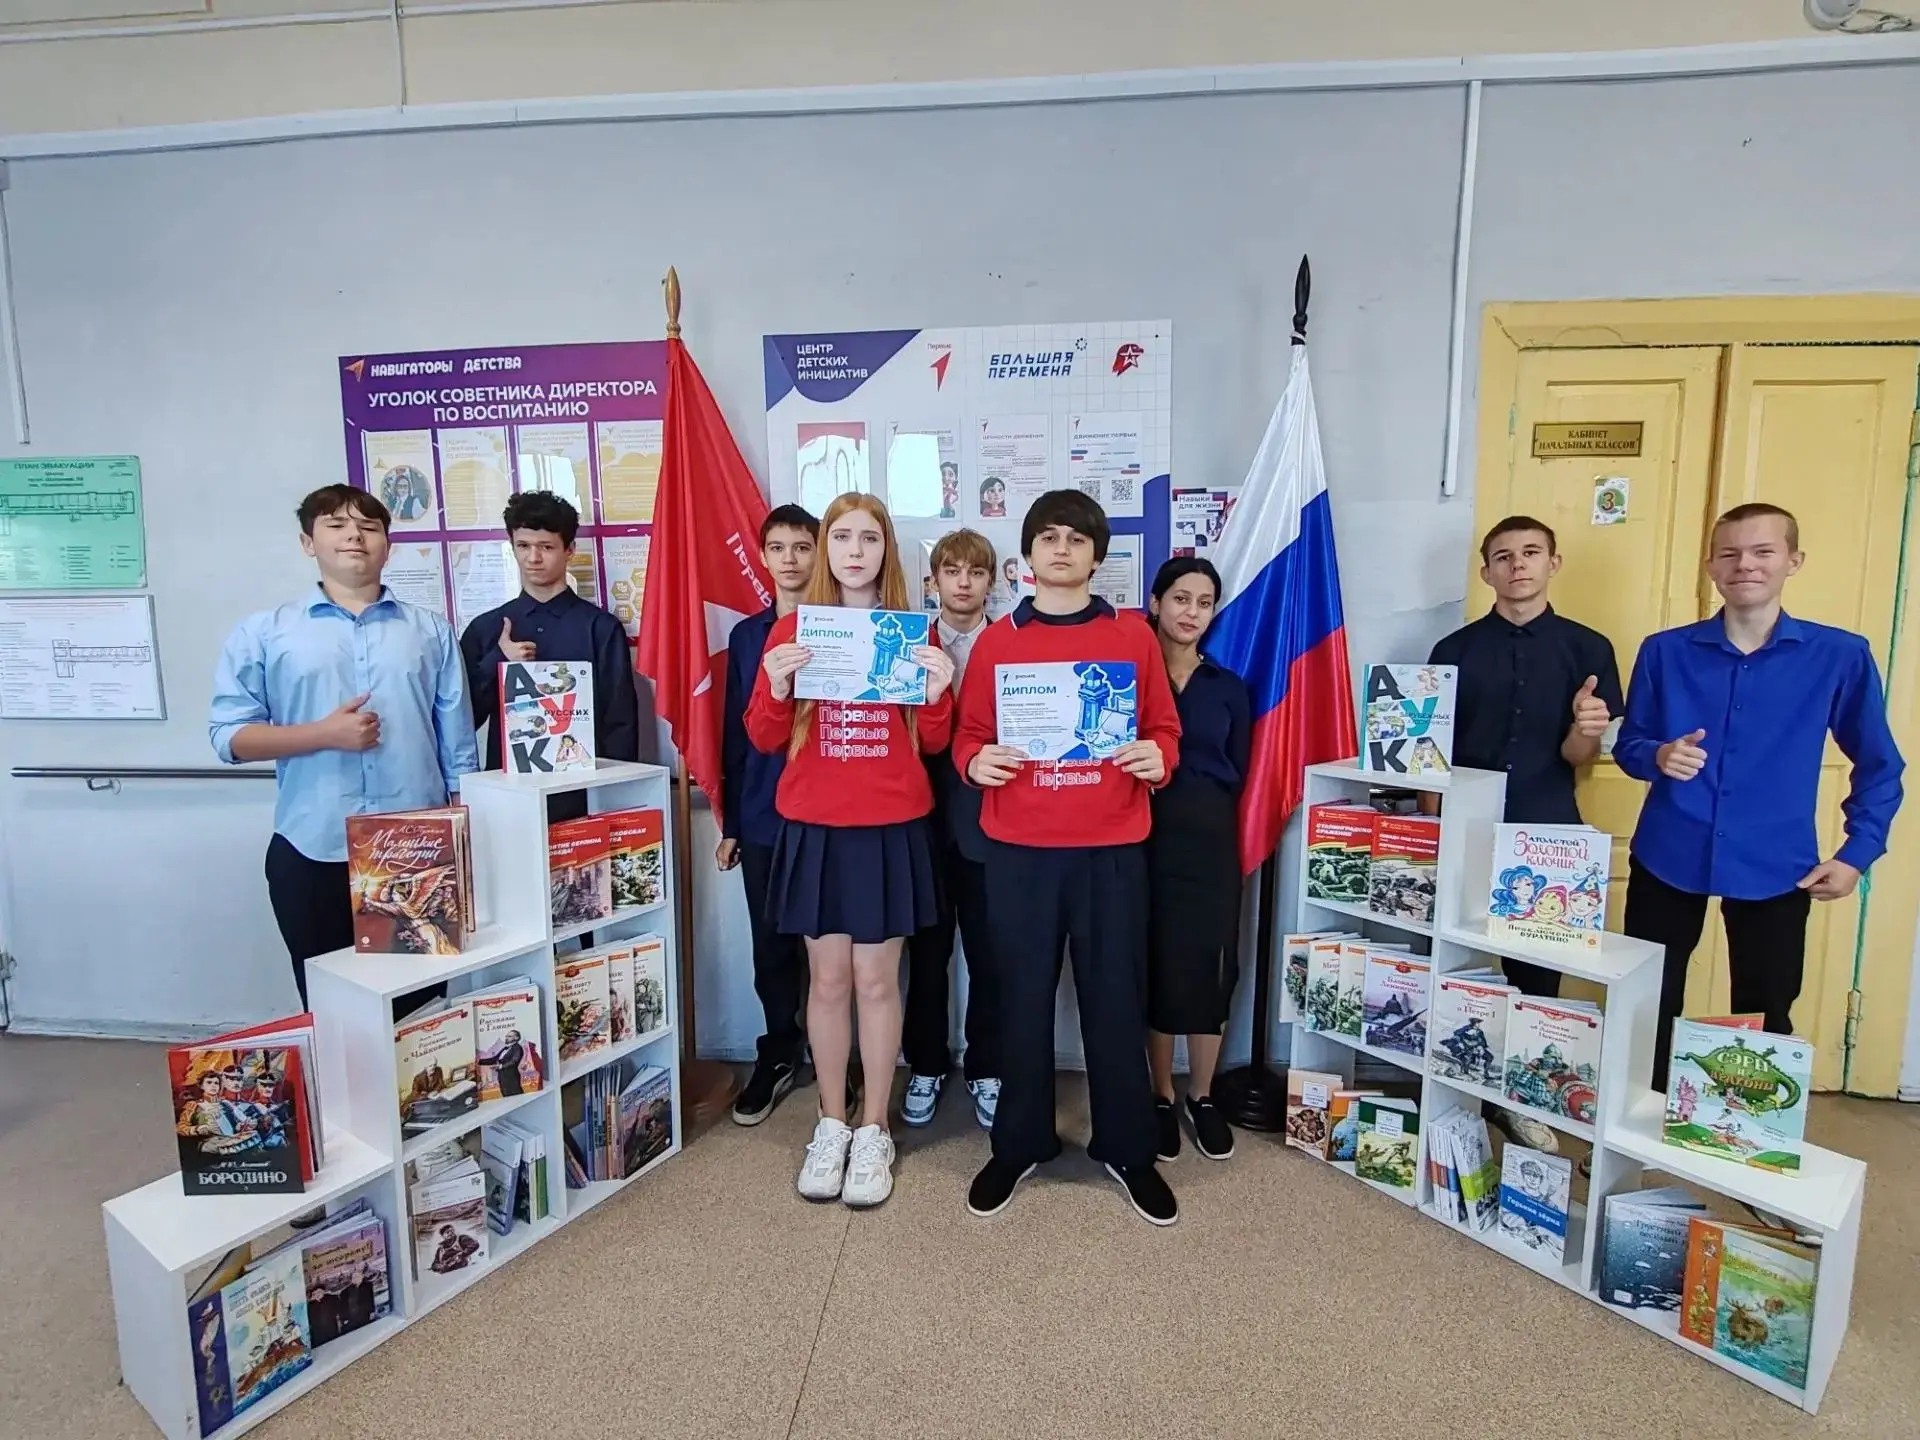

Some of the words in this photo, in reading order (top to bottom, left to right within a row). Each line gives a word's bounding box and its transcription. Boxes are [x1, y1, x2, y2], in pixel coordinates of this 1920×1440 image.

[797, 344, 833, 355] ЦЕНТР
[797, 356, 848, 368] ДЕТСКИХ
[990, 351, 1074, 366] БОЛЬШАЯ
[371, 361, 453, 377] НАВИГАТОРЫ
[464, 356, 522, 374] ДЕТСТВА
[988, 365, 1071, 379] ПЕРЕМЕНА
[798, 369, 868, 381] ИНИЦИАТИВ
[368, 389, 437, 407] УГОЛОК
[440, 384, 545, 404] СОВЕТНИКА
[549, 380, 657, 401] ДИРЕКТОРА
[434, 406, 459, 422] ПО
[463, 401, 589, 421] ВОСПИТАНИЮ
[1568, 430, 1608, 439] КАБИНЕТ
[1539, 440, 1592, 450] НАЧАЛЬНЫХ
[1595, 440, 1635, 449] КЛАССОВ
[1601, 492, 1615, 511] 3
[800, 628, 854, 639] ДИПЛОМ
[1002, 686, 1057, 696] ДИПЛОМ
[544, 709, 589, 717] РУССКИХ
[819, 706, 889, 726] Первые
[820, 724, 889, 744] Первые
[821, 741, 888, 761] Первые
[1033, 770, 1101, 791] Первые
[1316, 823, 1372, 834] СТАЛИНГРАДСКО
[353, 829, 448, 848] Маленькие
[1520, 931, 1569, 944] БУРАТИНО
[198, 1171, 287, 1184] БОРОДИНО
